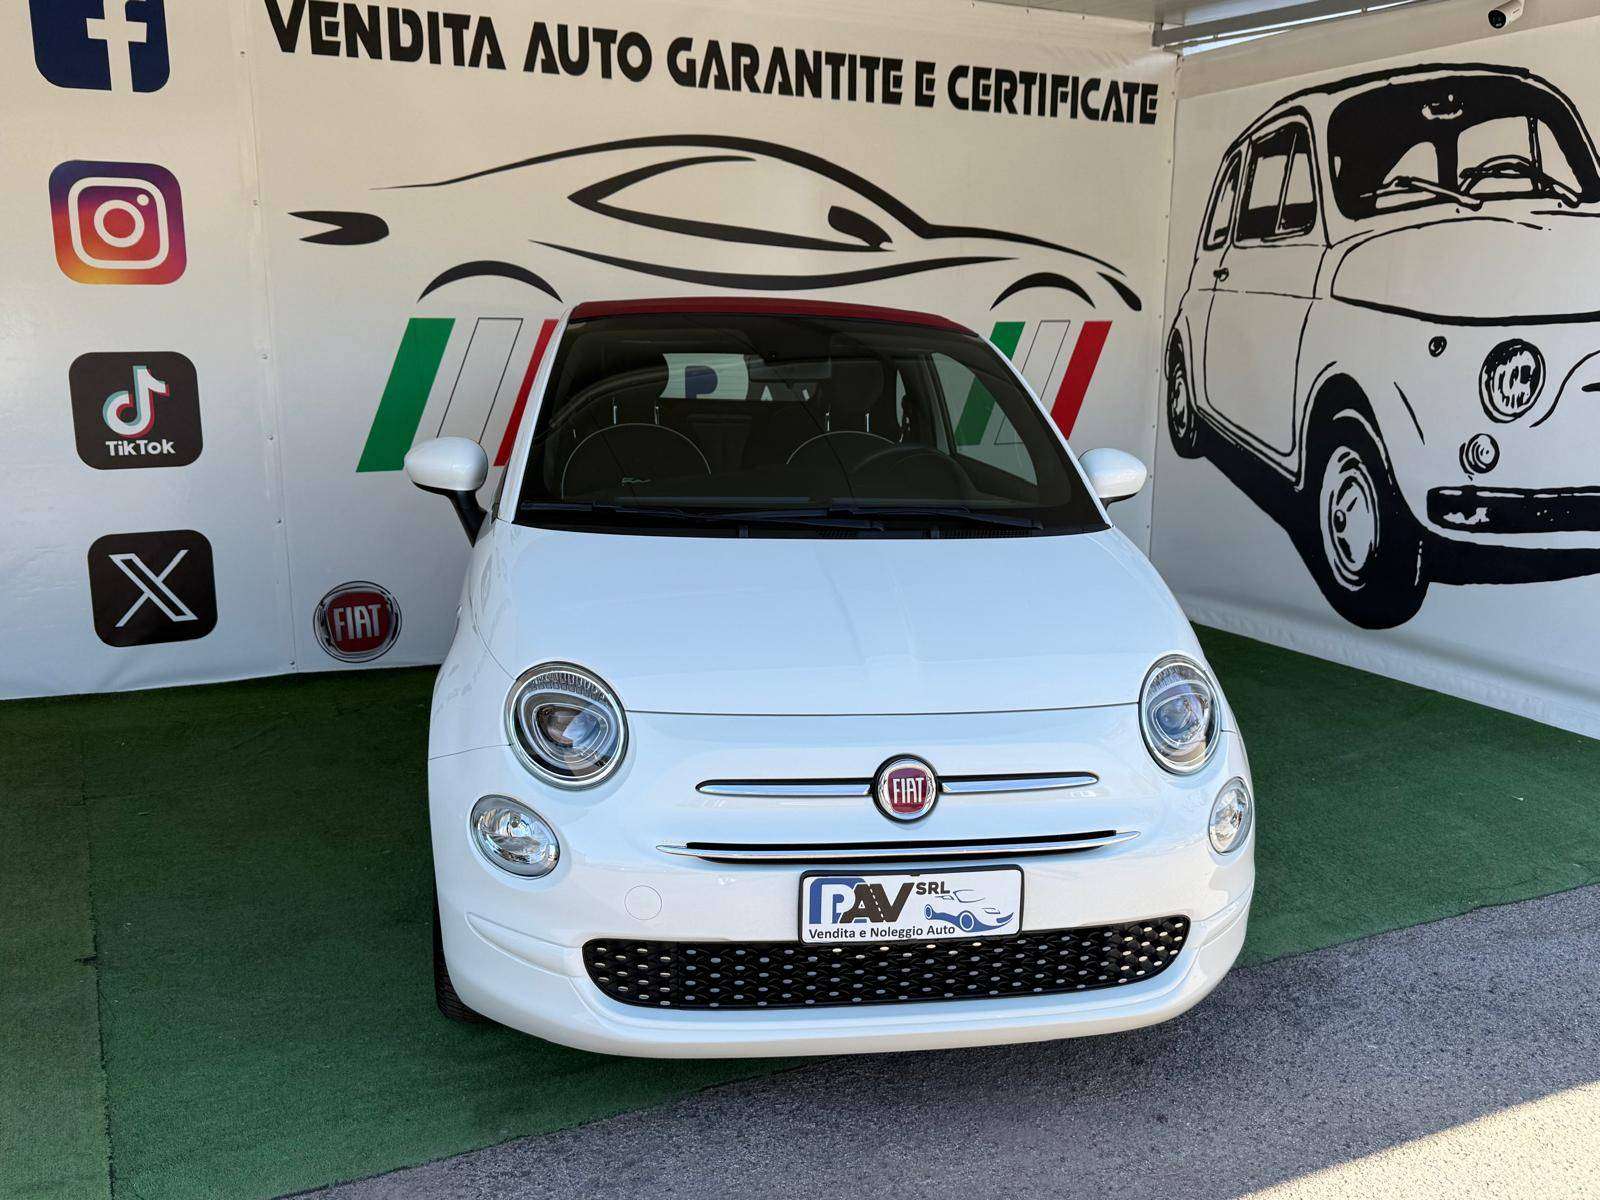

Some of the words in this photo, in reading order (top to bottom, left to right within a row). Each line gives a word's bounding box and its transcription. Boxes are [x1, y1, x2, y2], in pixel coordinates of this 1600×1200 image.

[265, 0, 506, 70] VENDITA
[523, 21, 653, 82] AUTO
[667, 36, 903, 105] GARANTITE
[914, 61, 936, 108] E
[947, 65, 1159, 125] CERTIFICATE
[105, 438, 176, 457] TikTok
[333, 603, 382, 643] FIAT
[893, 777, 924, 804] FIAT
[809, 877, 915, 925] PAV
[916, 881, 951, 895] SRL
[809, 927, 856, 940] Vendita
[859, 930, 867, 938] e
[870, 926, 923, 939] Noleggio
[927, 923, 956, 936] Auto
